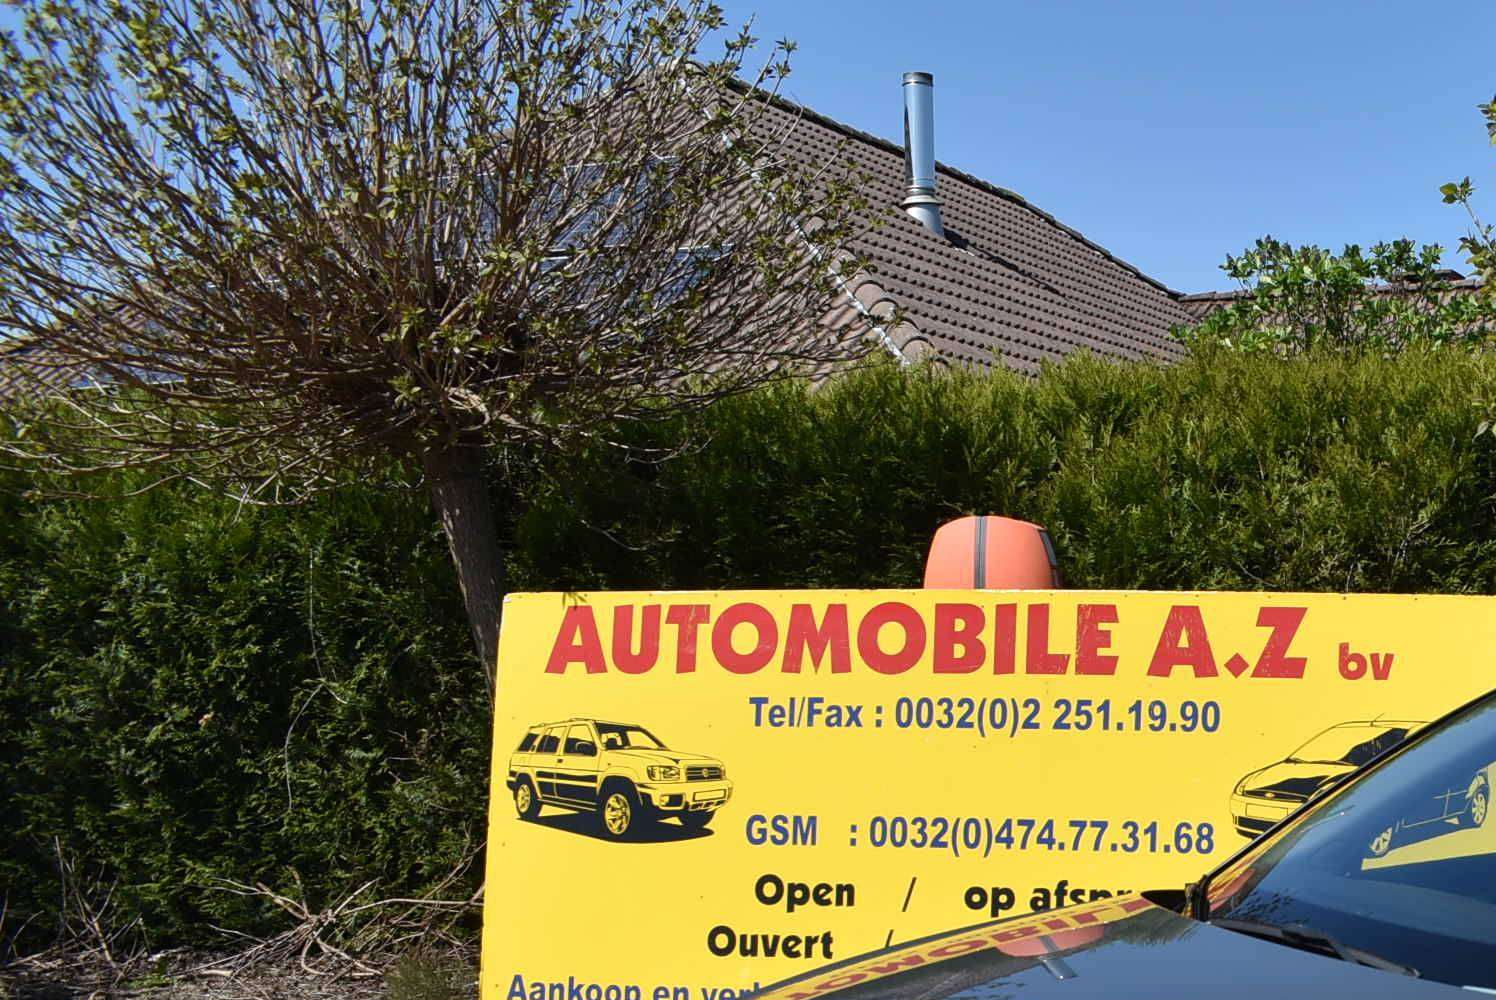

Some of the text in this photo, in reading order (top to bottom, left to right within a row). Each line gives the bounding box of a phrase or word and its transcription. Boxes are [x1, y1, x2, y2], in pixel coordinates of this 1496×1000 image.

[545, 602, 1395, 681] AUTOMOBILE A.Z bv
[749, 696, 863, 728] Tel/Fax
[895, 697, 1041, 738] 0032(0)2
[1052, 698, 1221, 733] 251.19.90
[745, 814, 818, 846] GSM
[869, 815, 1214, 858] 0032(0)474.77.31.68
[754, 873, 856, 914] Open
[964, 886, 1016, 918] op
[1029, 879, 1133, 912] afs
[707, 925, 834, 960] Ouvert
